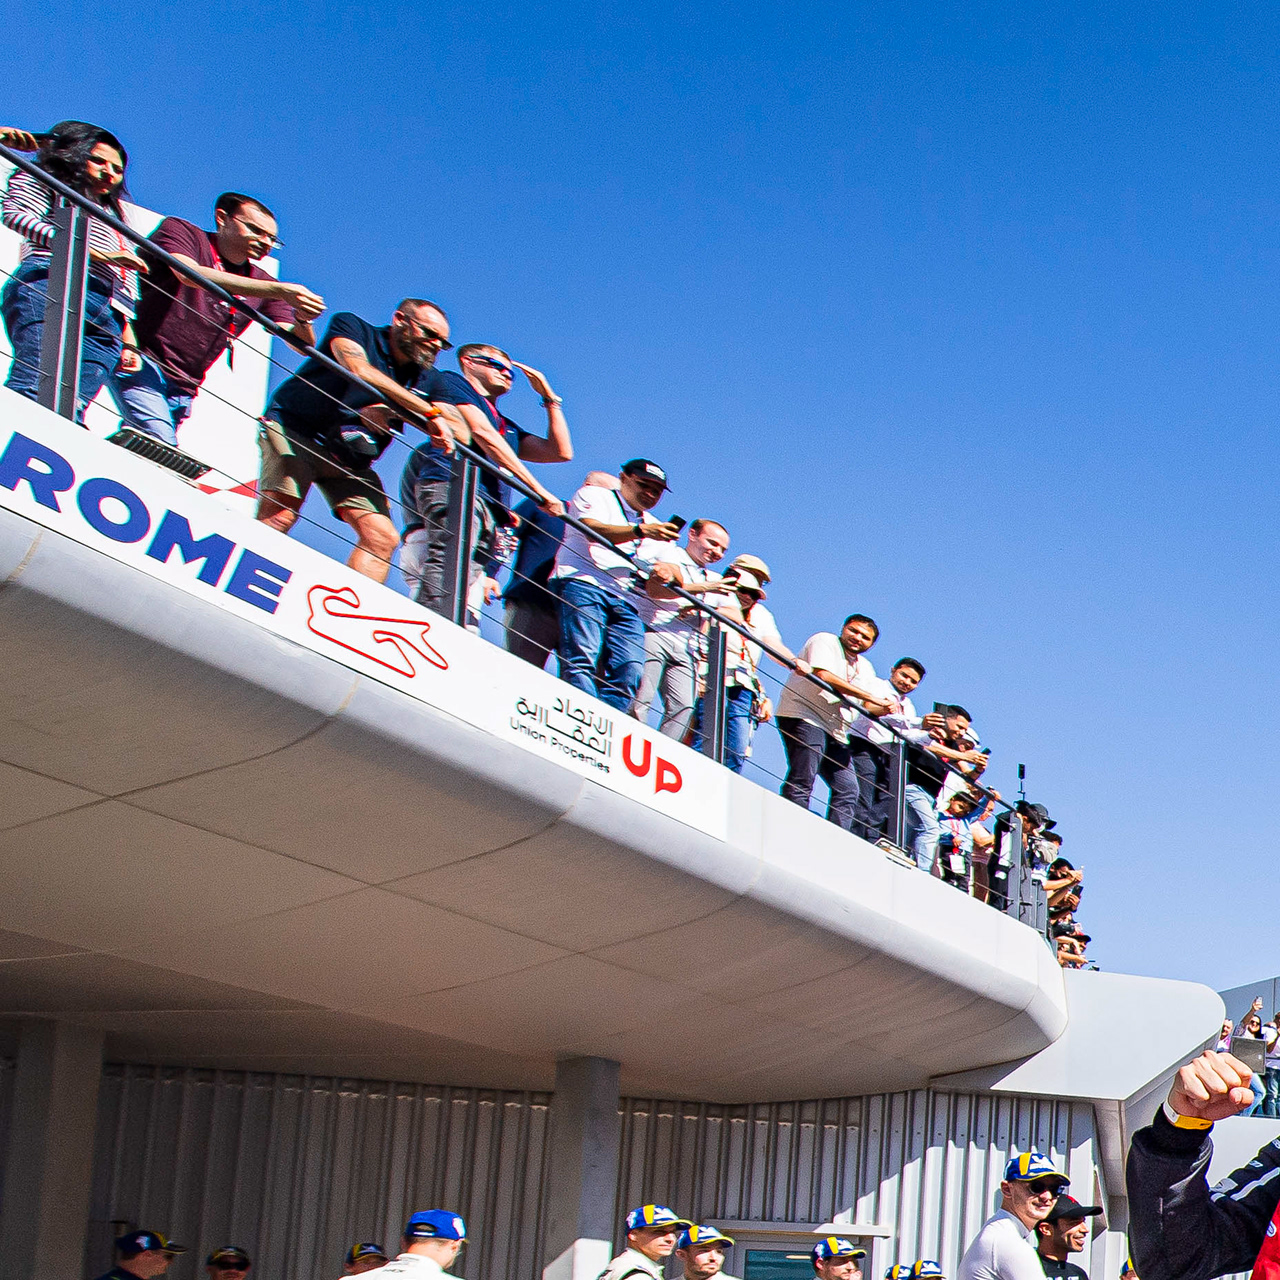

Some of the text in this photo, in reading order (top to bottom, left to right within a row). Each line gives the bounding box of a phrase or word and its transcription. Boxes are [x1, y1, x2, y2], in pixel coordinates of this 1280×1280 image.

[0, 431, 293, 614] ROME
[510, 716, 610, 773] Union Properties
[552, 697, 613, 737] الاتحاد
[622, 734, 682, 794] UP
